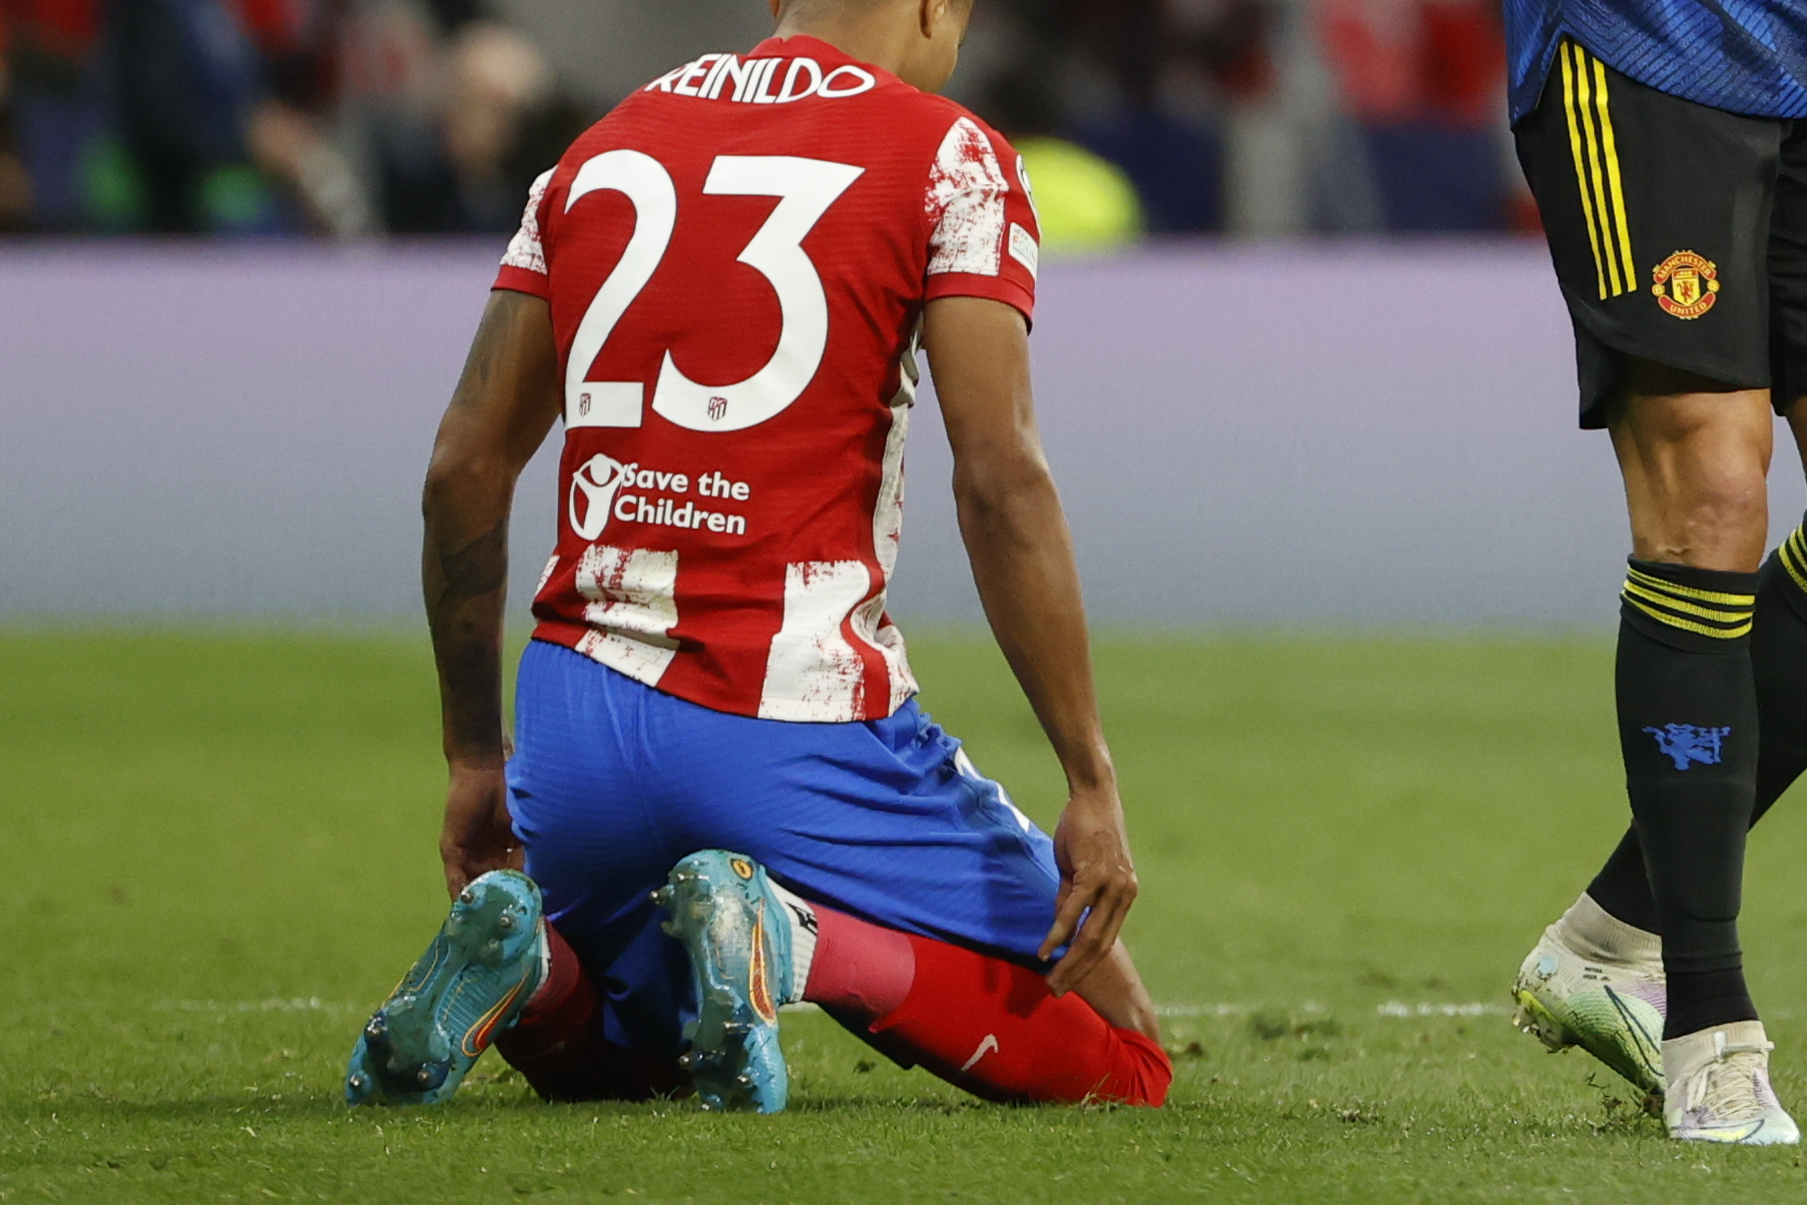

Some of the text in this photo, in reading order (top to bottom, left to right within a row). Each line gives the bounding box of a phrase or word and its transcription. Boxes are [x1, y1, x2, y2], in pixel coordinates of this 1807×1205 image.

[1657, 255, 1712, 279] MANCHESTER
[564, 149, 865, 432] 23
[1669, 301, 1708, 315] UNITED
[623, 462, 750, 500] Save the
[614, 494, 746, 535] Children
